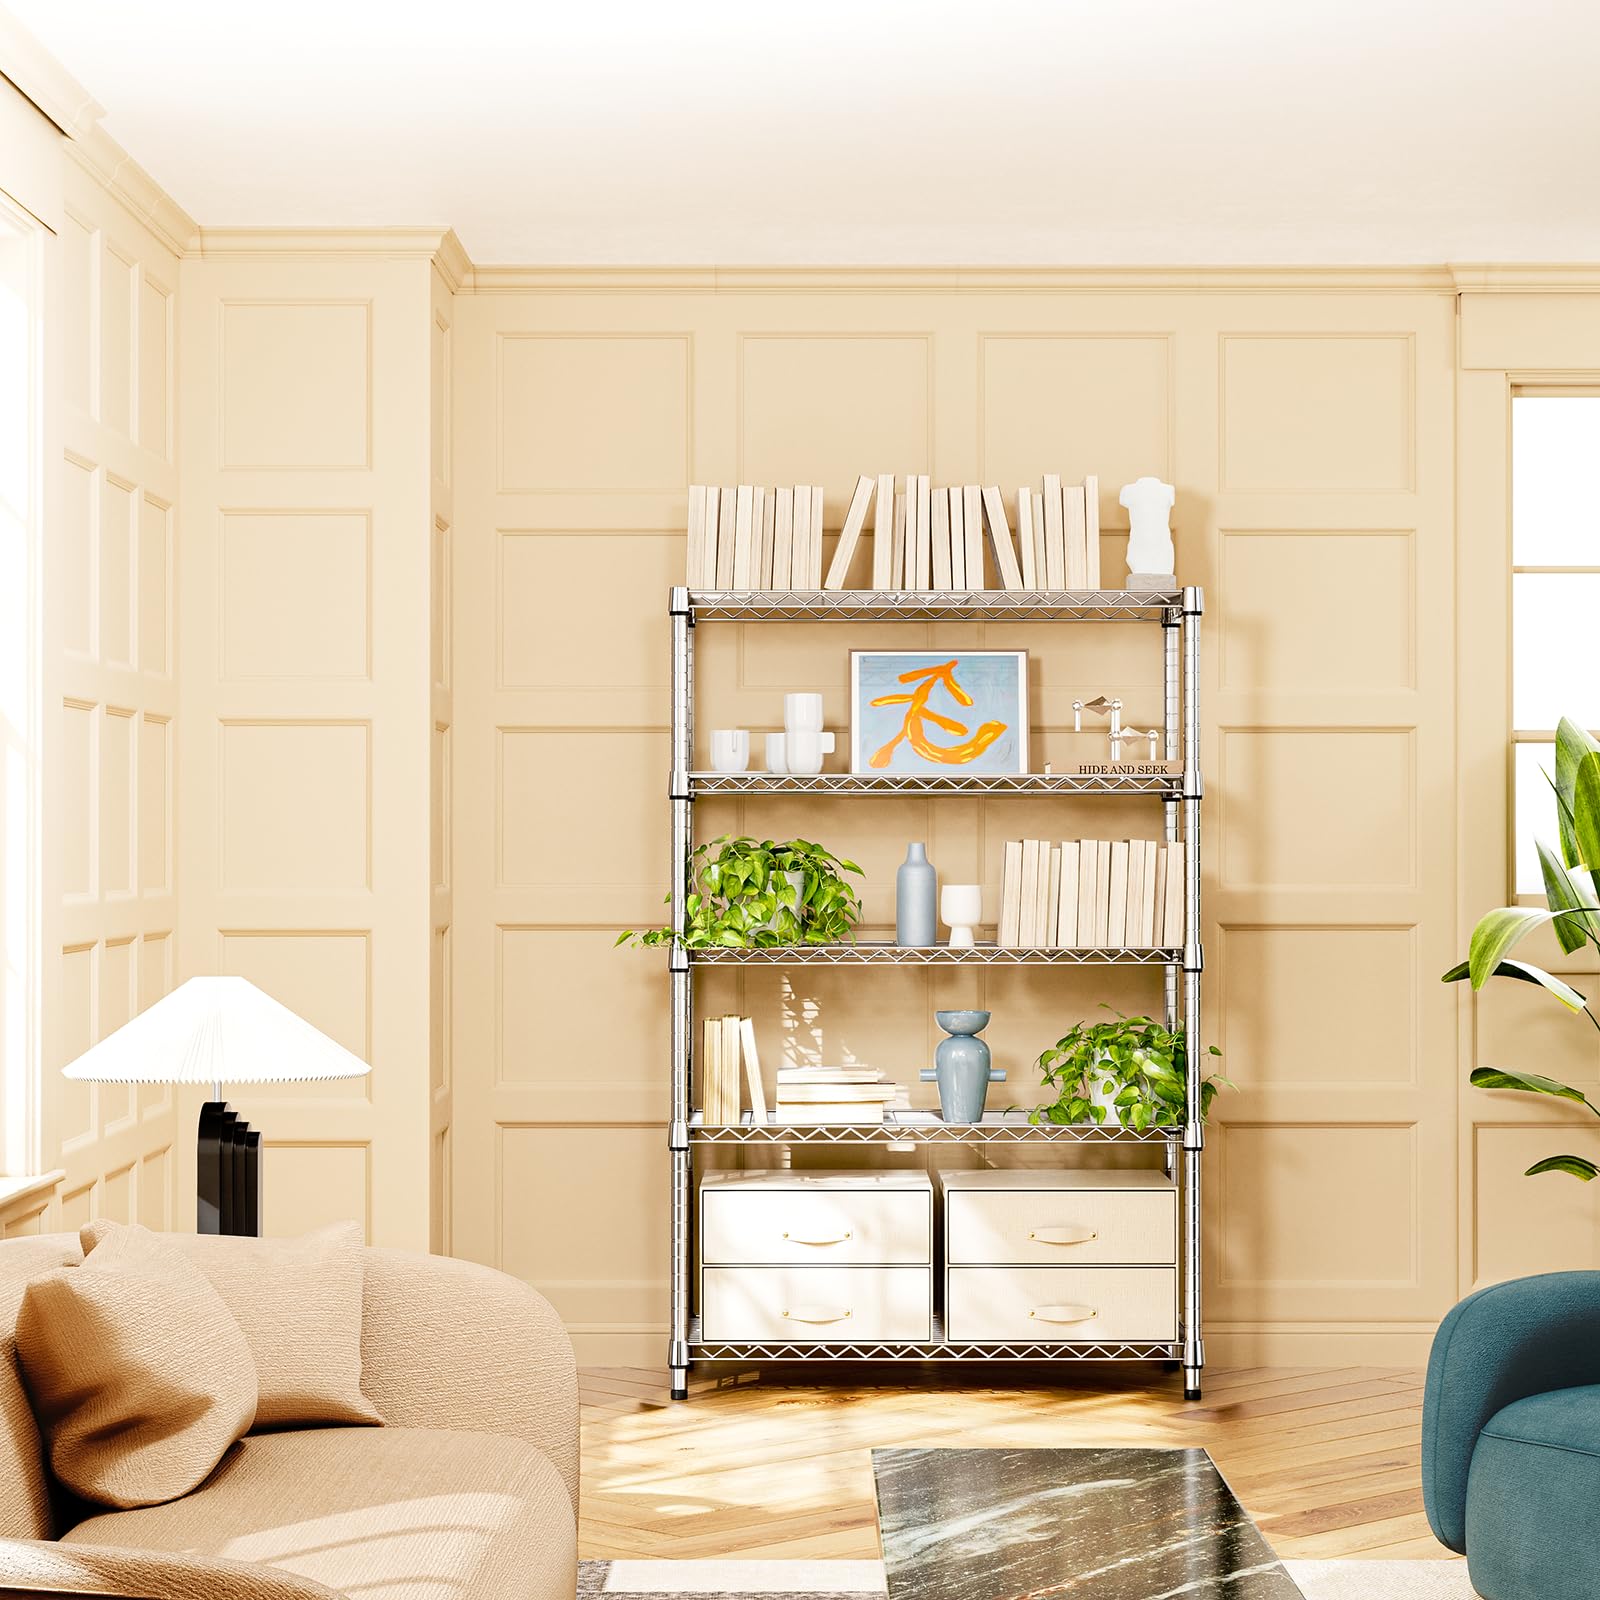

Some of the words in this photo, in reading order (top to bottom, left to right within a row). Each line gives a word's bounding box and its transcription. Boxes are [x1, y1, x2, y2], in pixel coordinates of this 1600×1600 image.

[1079, 765, 1108, 775] HIDE
[1109, 765, 1135, 775] AND
[1138, 765, 1168, 775] SEEK
